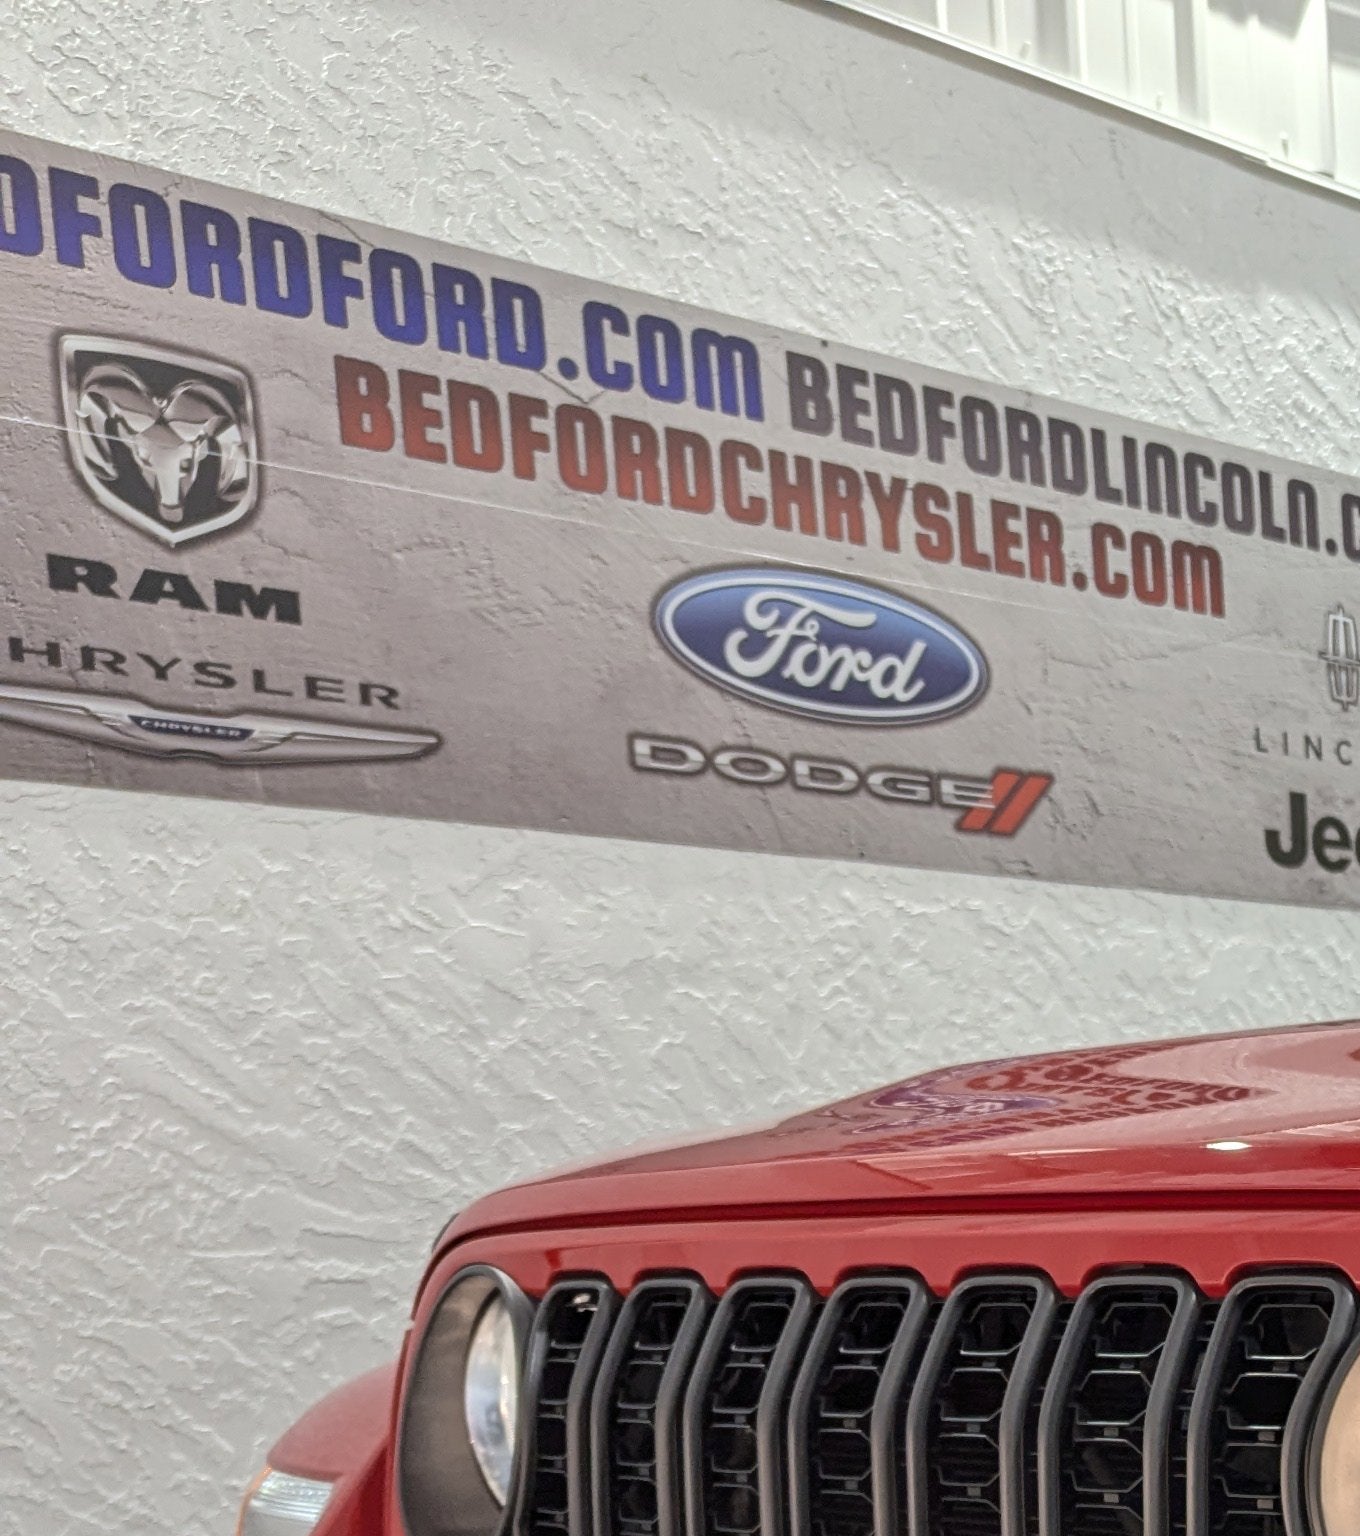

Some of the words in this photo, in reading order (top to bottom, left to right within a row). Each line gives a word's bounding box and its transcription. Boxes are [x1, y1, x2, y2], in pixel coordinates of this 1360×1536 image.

[334, 354, 1226, 619] BEDFORDCHRYSLER.COM
[46, 553, 302, 625] RAM
[724, 591, 927, 702] Ford
[630, 736, 998, 810] DODGE
